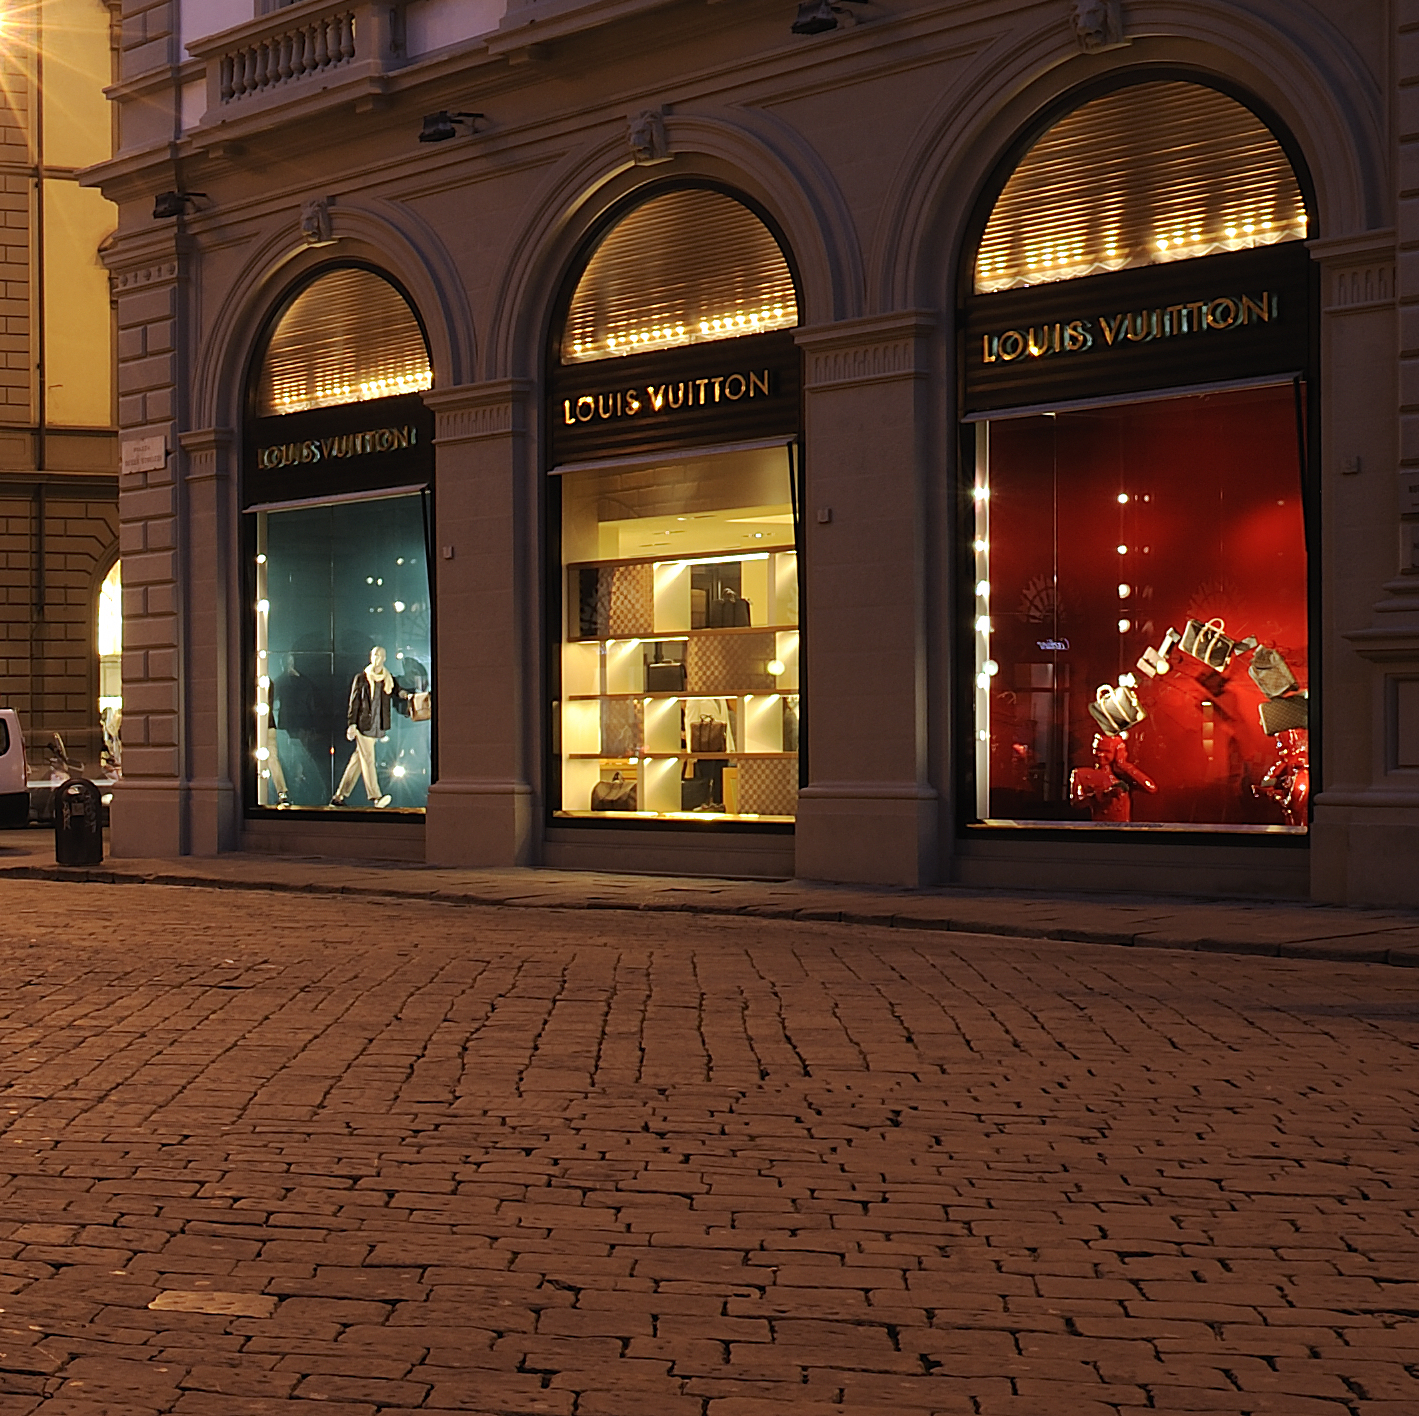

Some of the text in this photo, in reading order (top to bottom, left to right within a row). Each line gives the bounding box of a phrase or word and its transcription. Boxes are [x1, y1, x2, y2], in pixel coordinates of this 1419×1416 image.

[982, 291, 1269, 364] LOUIS VUITTON
[564, 369, 769, 425] LOUIS VUITTON
[257, 425, 409, 470] LOUIS VUITTON
